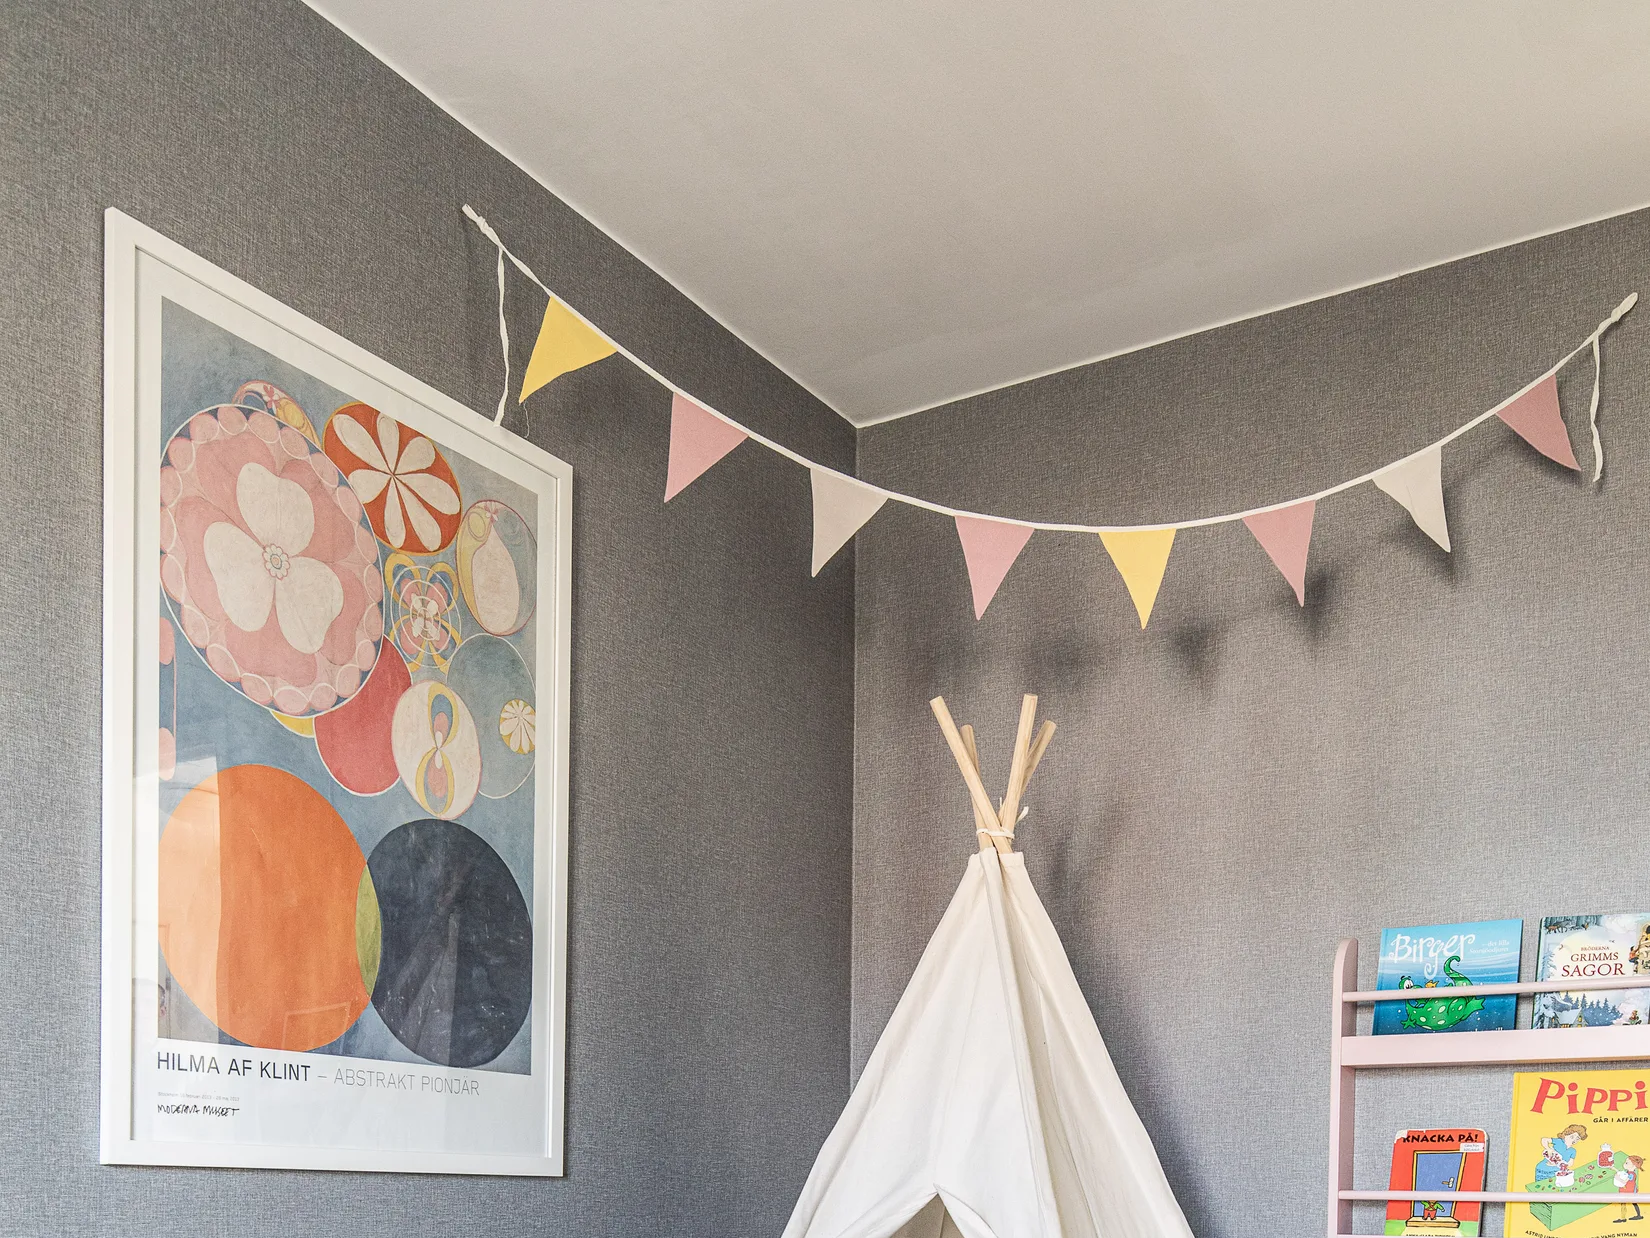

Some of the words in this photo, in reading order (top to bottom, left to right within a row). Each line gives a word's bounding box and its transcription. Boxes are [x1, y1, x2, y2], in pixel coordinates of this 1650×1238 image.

[1388, 933, 1476, 980] Birger
[1570, 951, 1619, 962] GRIMMS
[1561, 962, 1625, 977] SAGOR
[157, 1051, 220, 1075] HILMA
[227, 1058, 253, 1077] AF
[260, 1060, 311, 1082] KLINT
[333, 1067, 416, 1091] ABSTRAKT
[421, 1075, 480, 1096] PIONJÄR
[157, 1103, 200, 1115] MODERNA
[203, 1104, 240, 1117] MUSEET
[1402, 1134, 1455, 1143] KNACKA
[1458, 1132, 1479, 1143] PÅ!
[1525, 1230, 1543, 1238] ASTRID
